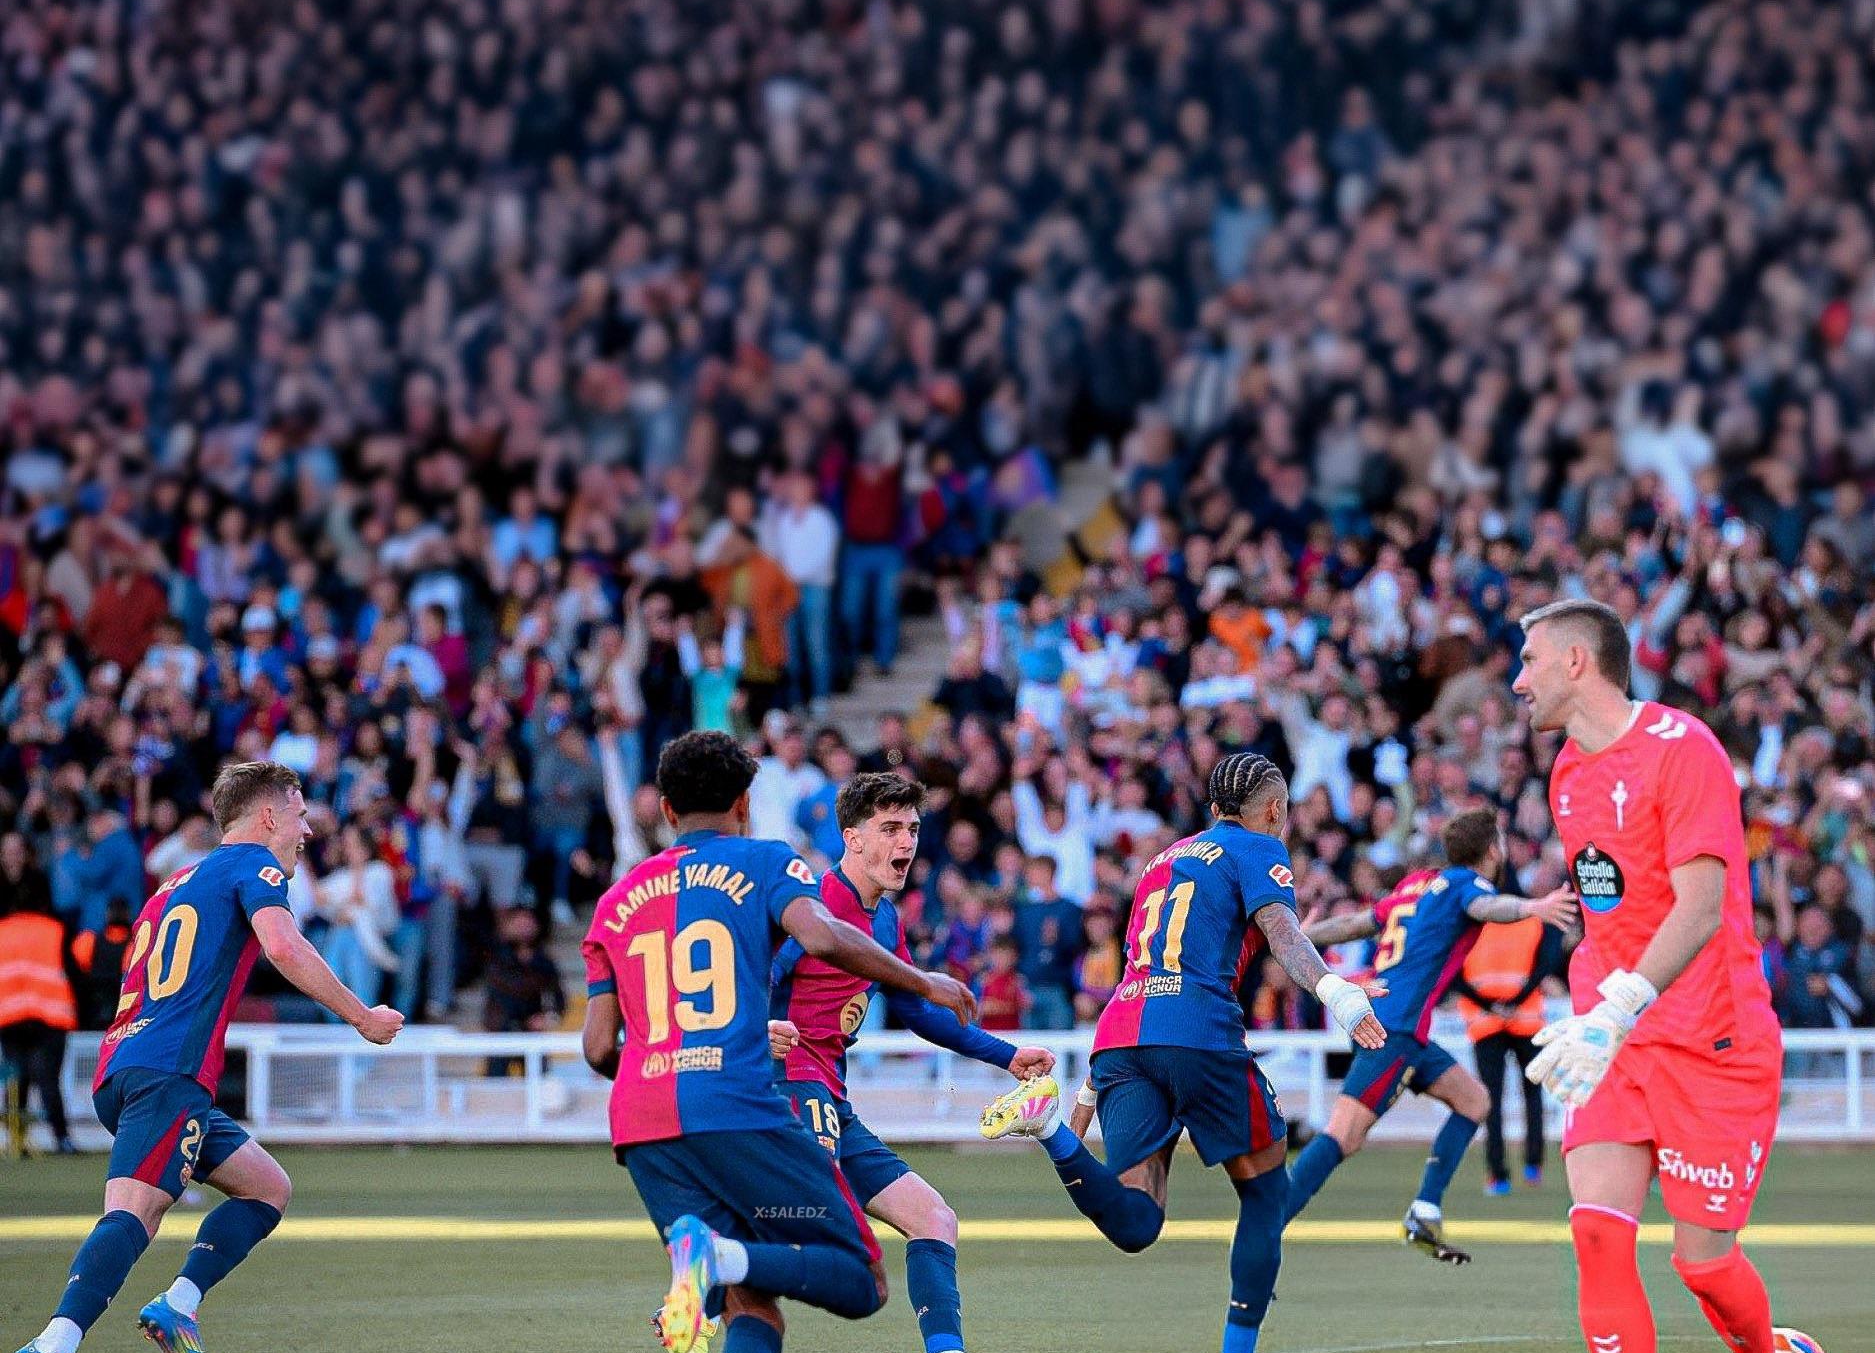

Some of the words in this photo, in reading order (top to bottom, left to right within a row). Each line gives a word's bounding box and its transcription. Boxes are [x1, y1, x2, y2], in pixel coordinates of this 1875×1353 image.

[604, 869, 681, 934] LAMINE
[684, 863, 755, 906] YAMAL
[1576, 859, 1616, 878] Estrella
[115, 904, 198, 1019] 20
[1134, 881, 1195, 973] 11
[1374, 903, 1417, 972] 5
[626, 918, 737, 1045] 19
[1143, 983, 1182, 994] ACNUR
[1144, 975, 1182, 987] UNHCR
[805, 1098, 841, 1139] 18
